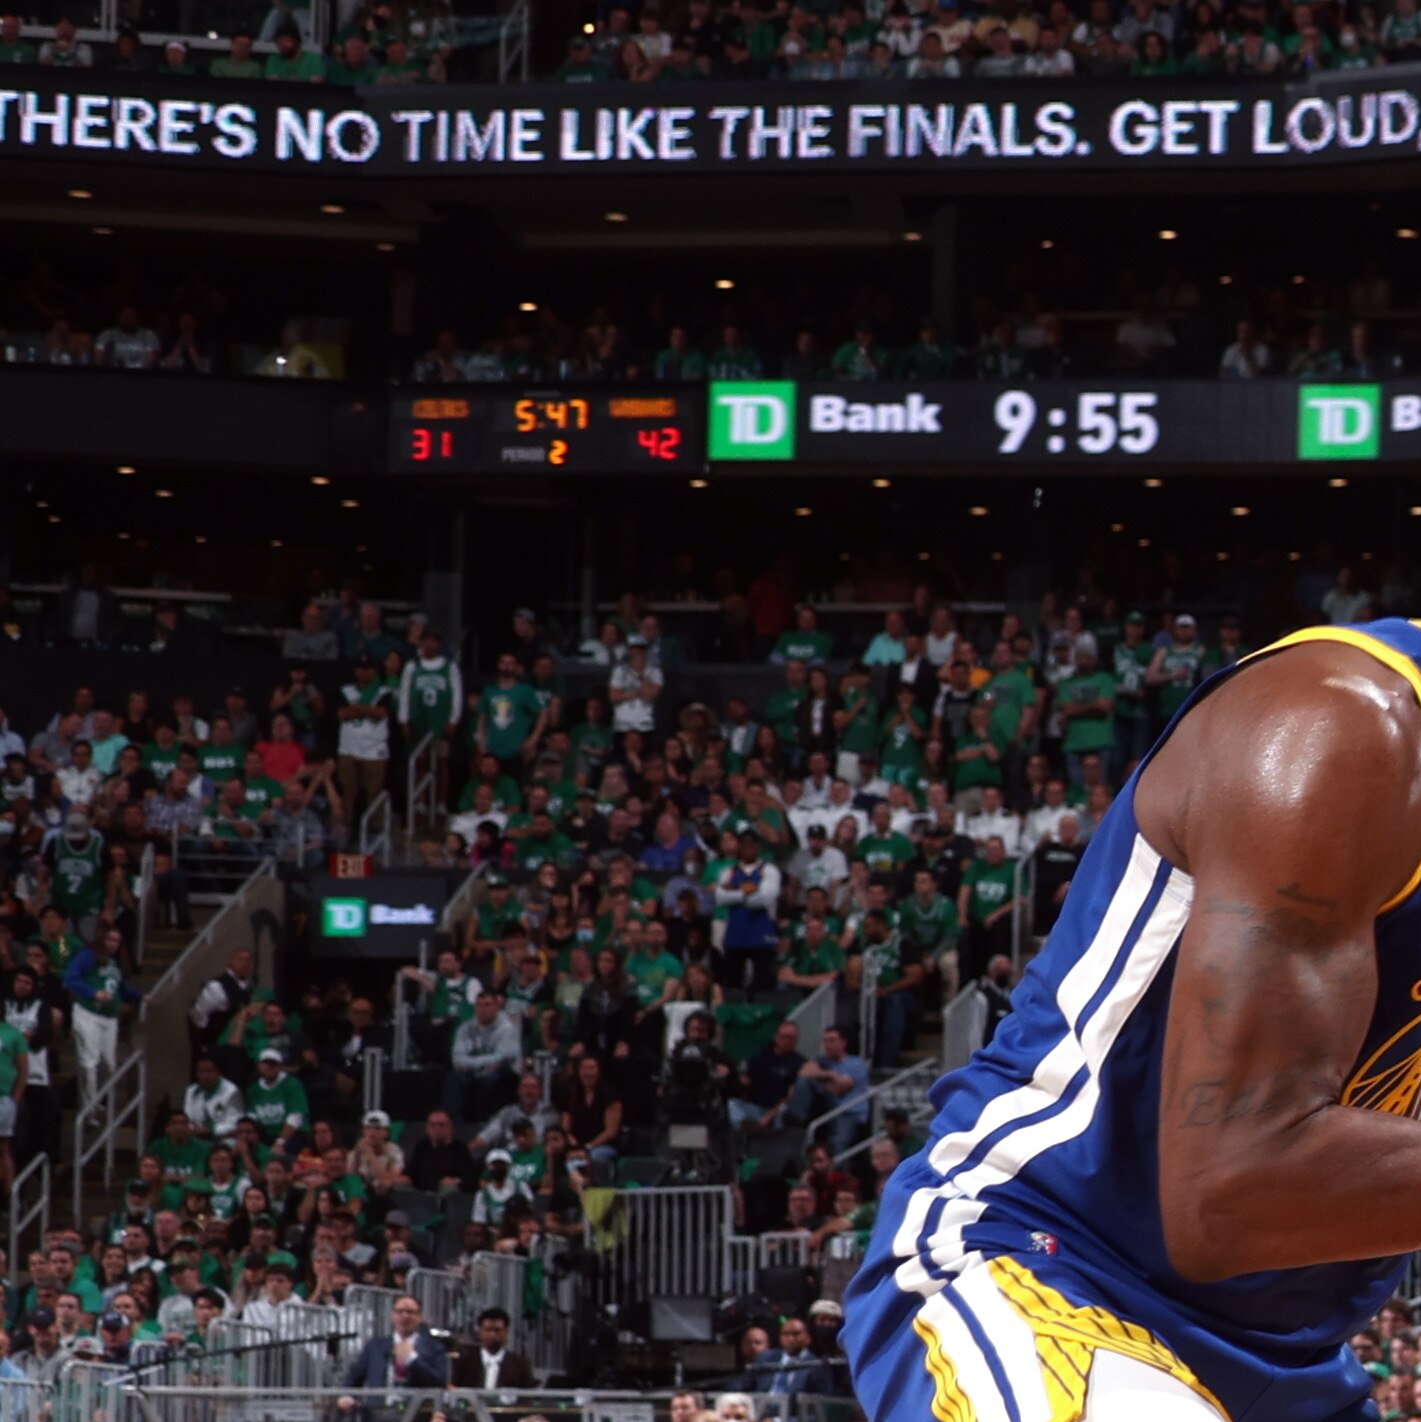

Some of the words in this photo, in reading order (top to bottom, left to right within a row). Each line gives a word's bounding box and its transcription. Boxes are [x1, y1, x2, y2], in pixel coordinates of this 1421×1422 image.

[275, 106, 380, 162] NO
[392, 109, 545, 162] TIME
[560, 108, 697, 161] LIKE
[709, 106, 833, 161] THE
[847, 102, 1092, 158] FINALS.
[1109, 100, 1240, 156] GET
[515, 399, 589, 432] 5:47
[718, 395, 787, 444] TD
[809, 393, 941, 433] Bank
[994, 390, 1160, 454] 9:55
[1306, 397, 1373, 444] TD
[412, 428, 453, 461] 31
[548, 439, 568, 465] 2
[637, 427, 681, 460] 42
